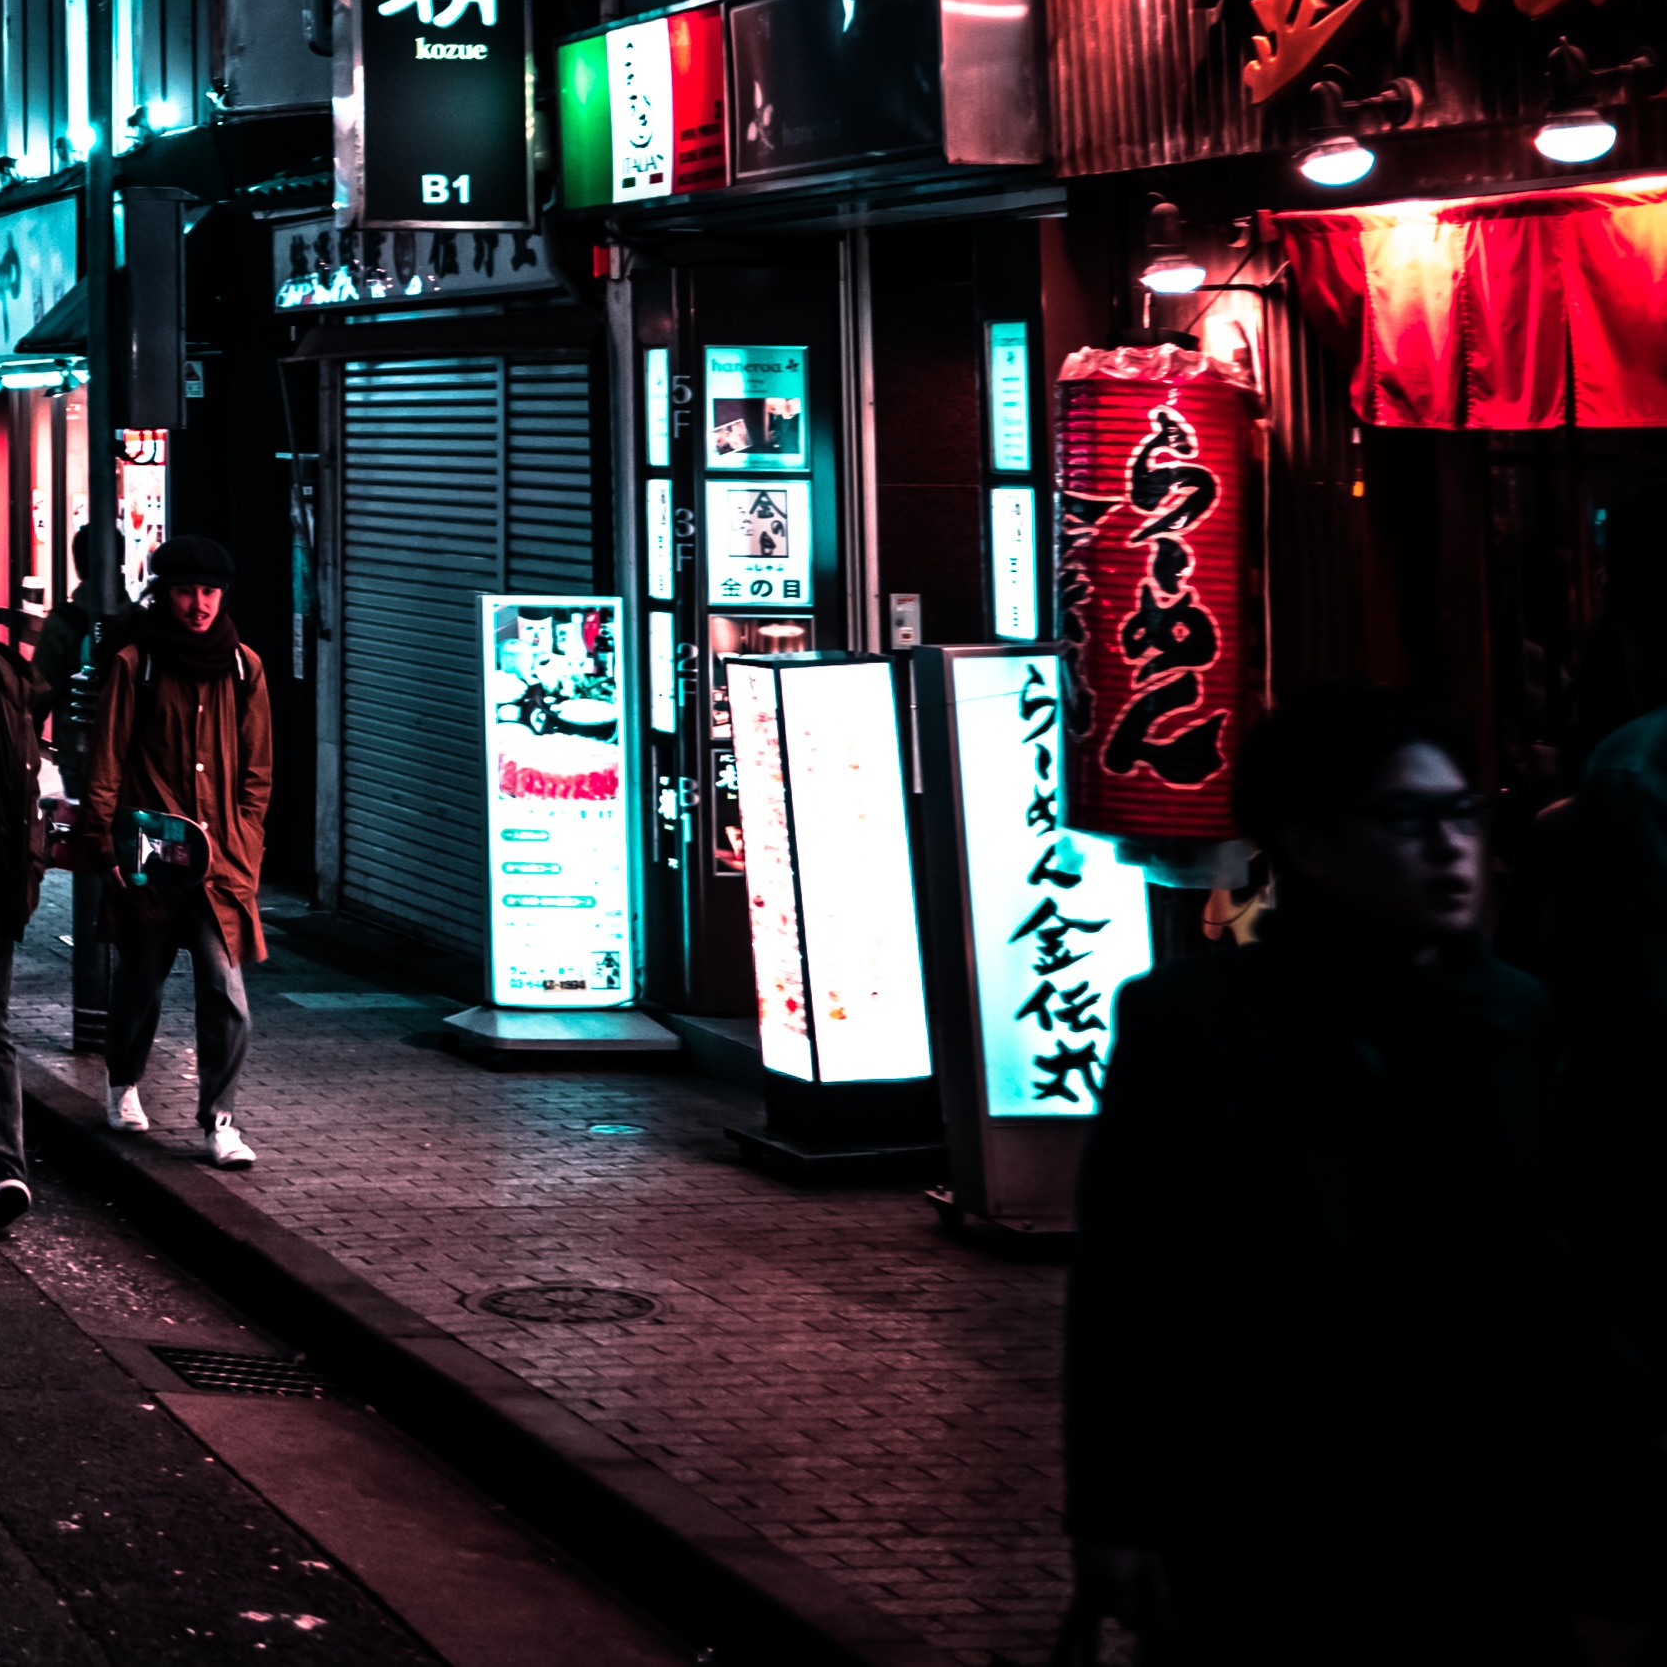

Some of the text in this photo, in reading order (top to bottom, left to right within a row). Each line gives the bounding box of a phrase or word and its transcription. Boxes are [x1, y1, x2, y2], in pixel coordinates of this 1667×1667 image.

[415, 38, 489, 62] kozue
[421, 173, 471, 205] B1
[719, 577, 802, 599] 金の目
[1104, 404, 1227, 793] らーめん
